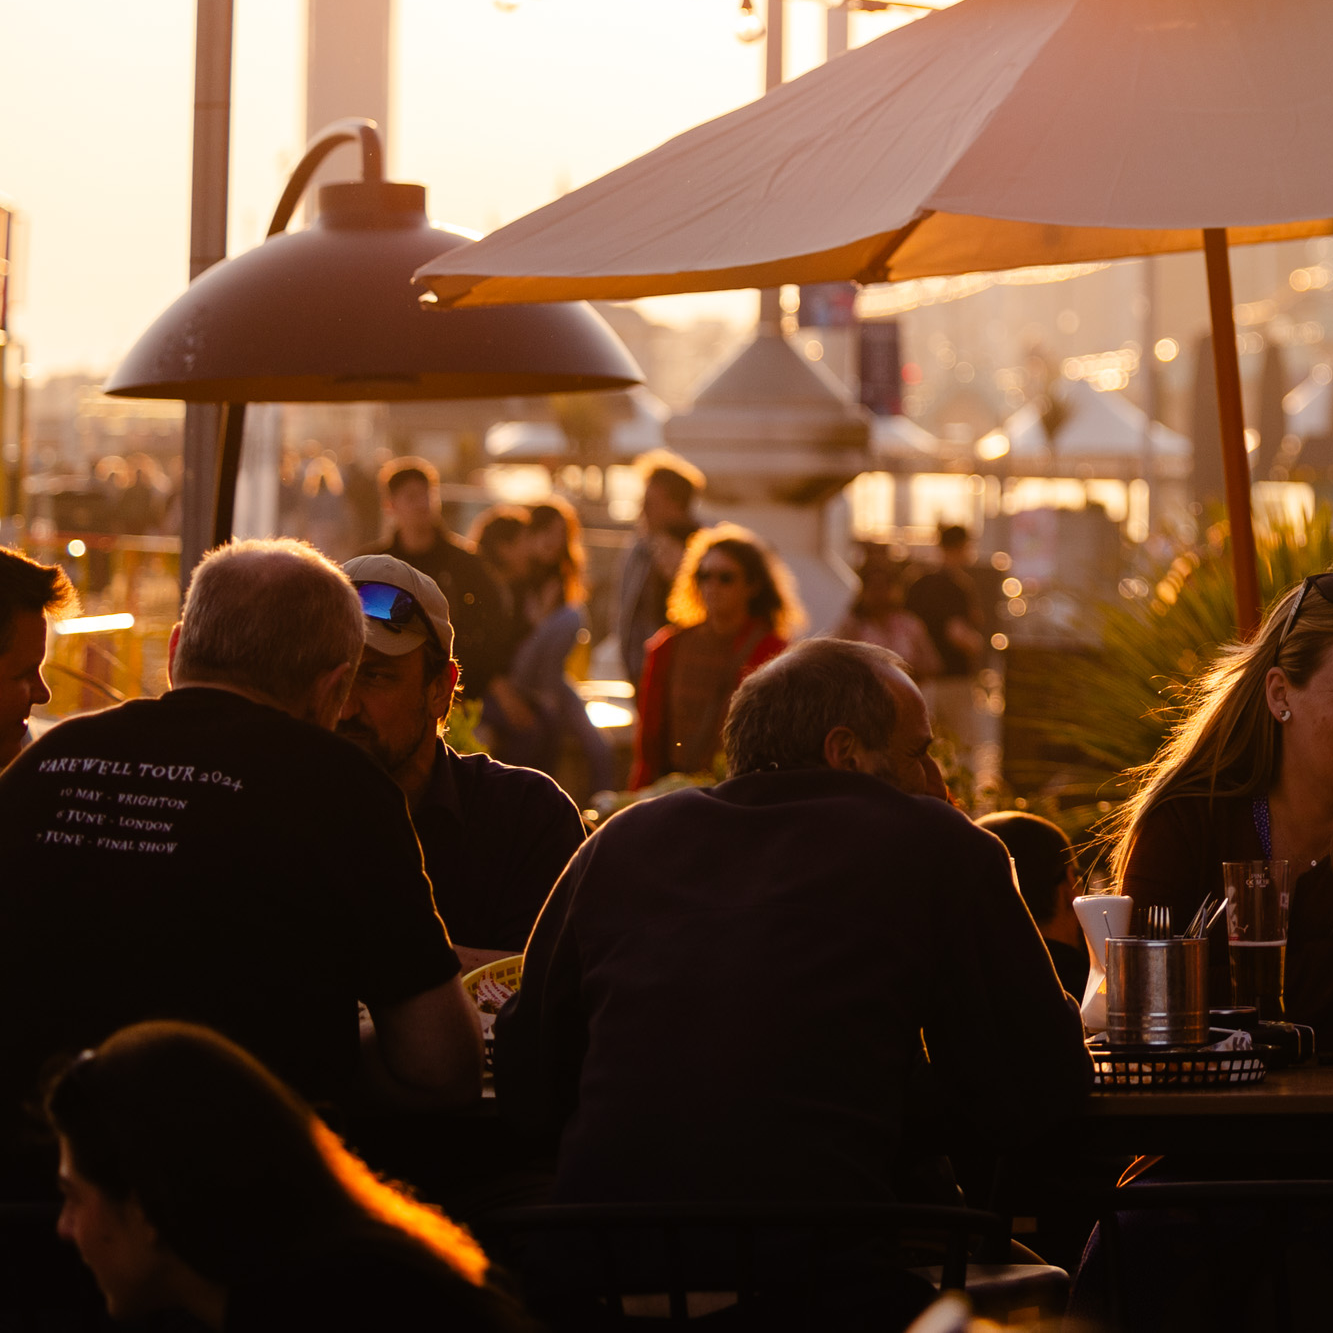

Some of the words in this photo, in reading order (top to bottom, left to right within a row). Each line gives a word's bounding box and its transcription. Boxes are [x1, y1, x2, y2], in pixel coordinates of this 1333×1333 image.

[39, 758, 131, 775] FAREWELL
[138, 763, 195, 782] TOUR
[198, 771, 243, 792] 2024
[75, 788, 103, 801] MAY
[117, 793, 188, 810] BRIGHTON
[67, 809, 106, 825] JUNE
[119, 816, 173, 832] LONDON
[45, 830, 84, 845] JUNE
[97, 838, 134, 851] FINAL
[138, 841, 177, 853] SHOW
